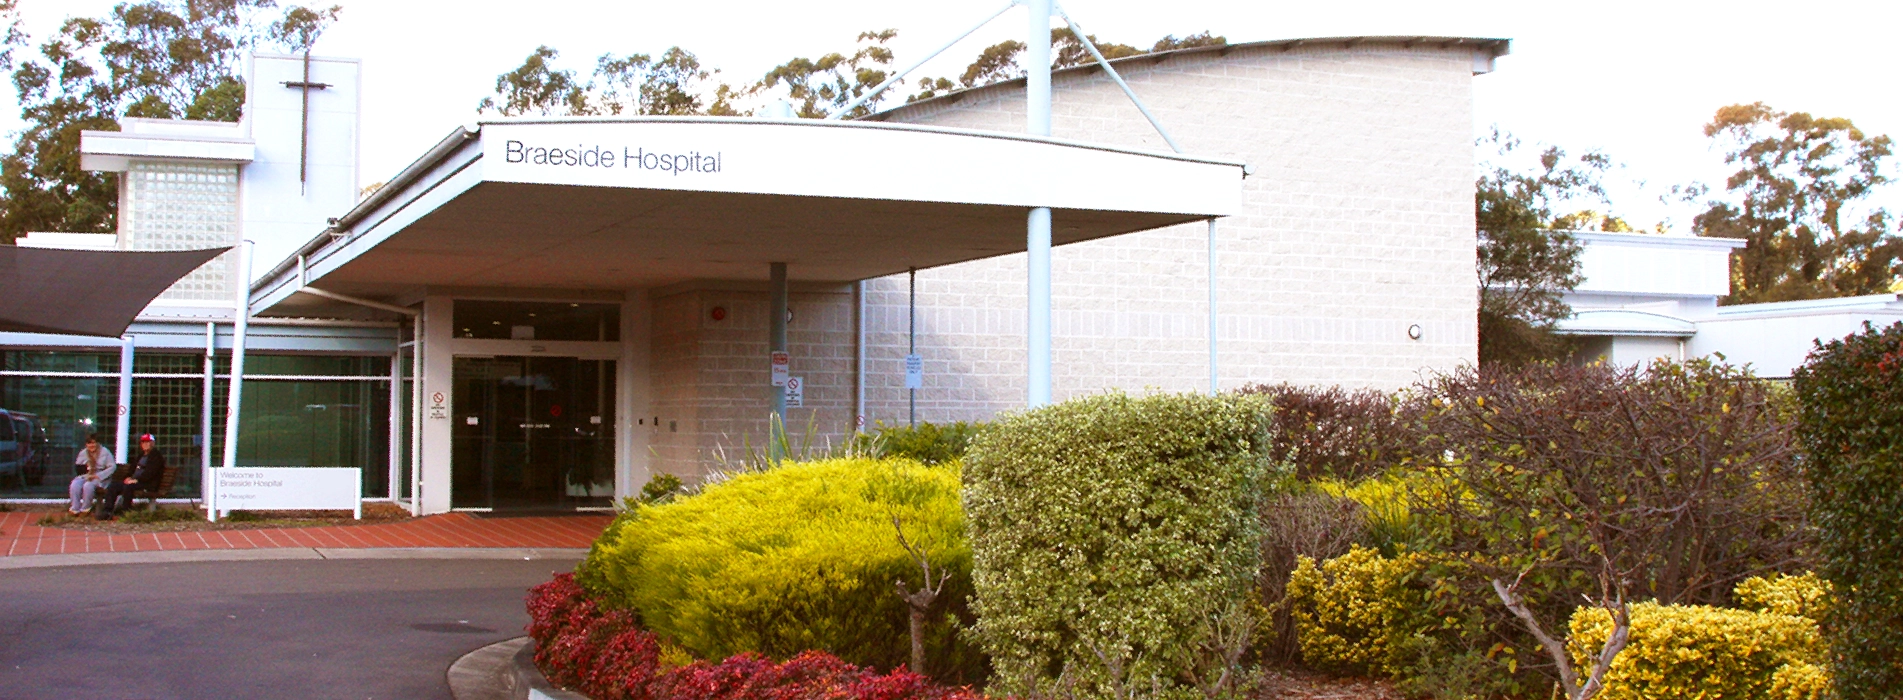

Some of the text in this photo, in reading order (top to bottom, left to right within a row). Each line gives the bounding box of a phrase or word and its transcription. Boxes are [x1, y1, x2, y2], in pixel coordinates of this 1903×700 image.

[506, 139, 722, 176] Braeside Hospital
[253, 480, 283, 488] Hospital
